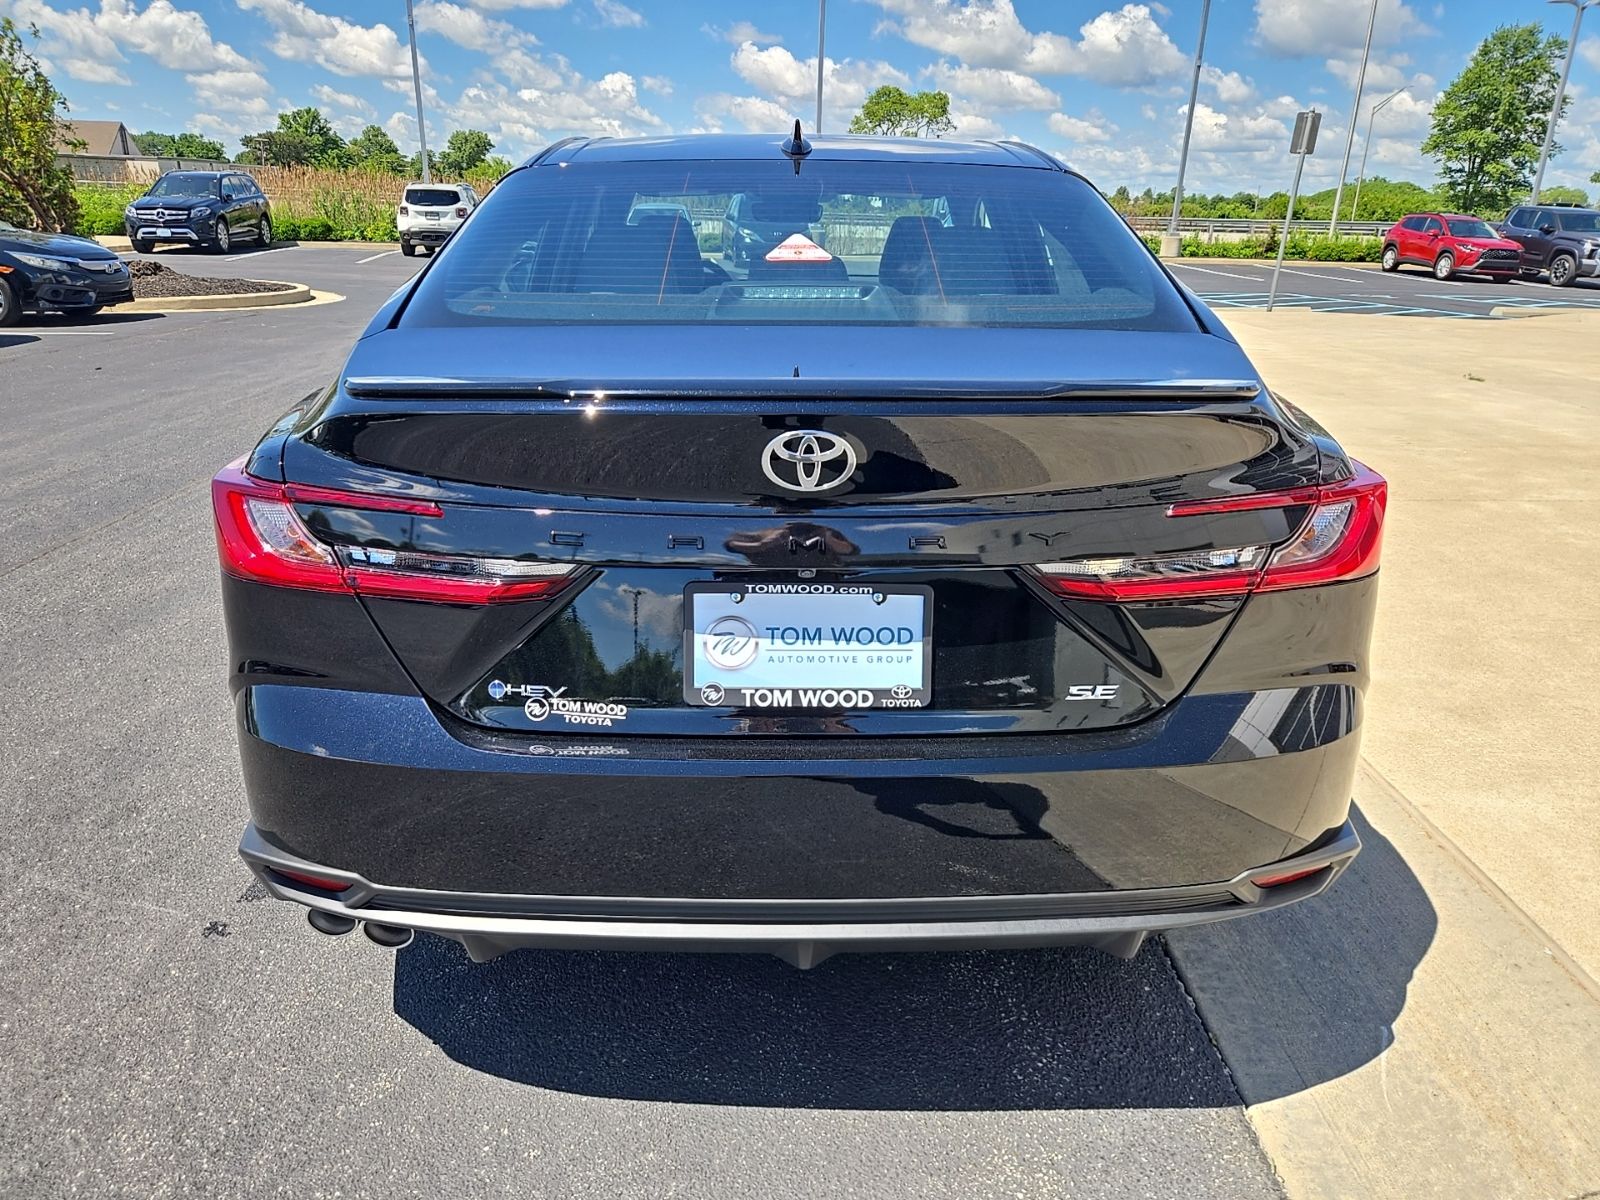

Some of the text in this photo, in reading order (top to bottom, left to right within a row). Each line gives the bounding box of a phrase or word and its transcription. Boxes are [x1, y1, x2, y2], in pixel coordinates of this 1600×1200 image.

[745, 584, 874, 595] TOMWOOD.com
[765, 627, 915, 646] TOM WOOD
[767, 655, 914, 664] AUTOMOTIVE GROUP
[506, 683, 568, 698] HEV
[1064, 685, 1120, 701] SE
[741, 689, 875, 708] TOM WOOD
[881, 699, 923, 708] TOYOTA
[552, 700, 628, 716] TOM WOOD
[563, 715, 613, 727] TOYOTA
